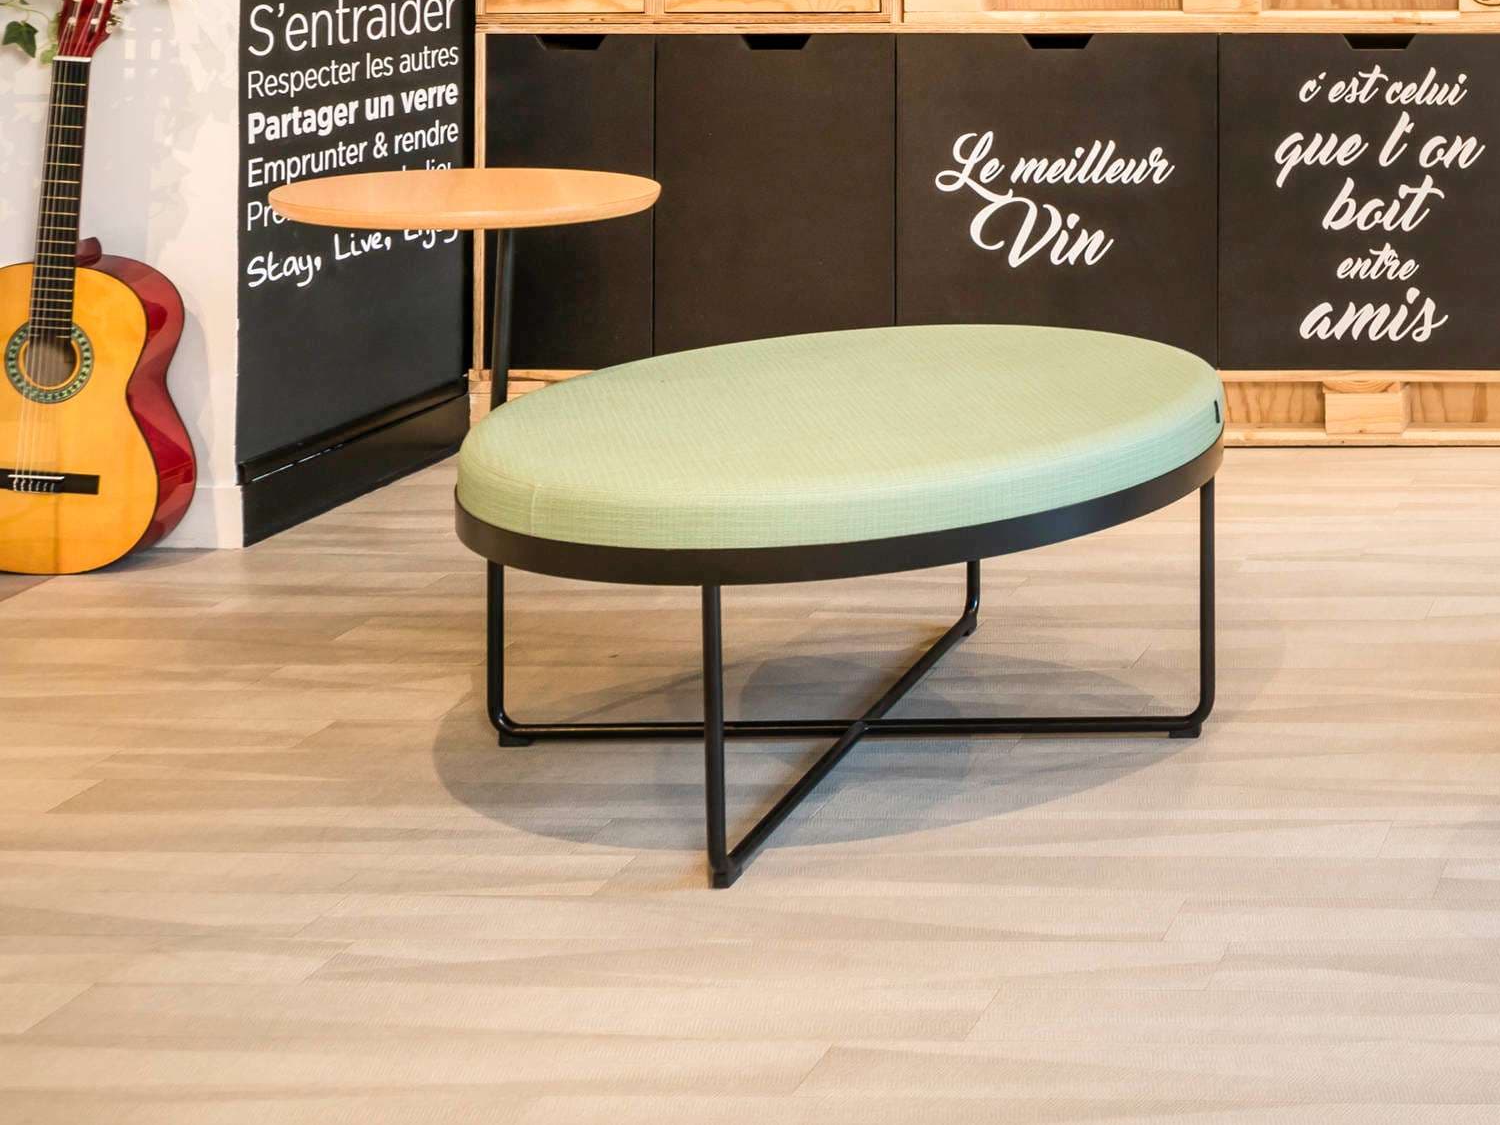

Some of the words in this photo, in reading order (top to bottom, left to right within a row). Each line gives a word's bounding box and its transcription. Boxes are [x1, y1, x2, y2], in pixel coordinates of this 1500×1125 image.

[248, 60, 360, 99] Respecter
[366, 52, 394, 79] les
[399, 46, 459, 72] autres
[1385, 67, 1467, 106] celui
[248, 100, 359, 144] Partager
[365, 93, 394, 122] un
[399, 82, 458, 114] verre
[248, 140, 367, 188] Emprunter
[373, 131, 388, 159] &
[394, 119, 459, 154] rendre
[935, 130, 1012, 200] Le
[1010, 139, 1175, 184] meilleur
[1274, 132, 1369, 188] que
[1322, 174, 1445, 232] boit
[247, 250, 321, 288] Stay,
[334, 231, 391, 260] Live,
[970, 197, 1114, 268] Vin
[1337, 242, 1419, 280] entre
[1300, 287, 1448, 343] amis
